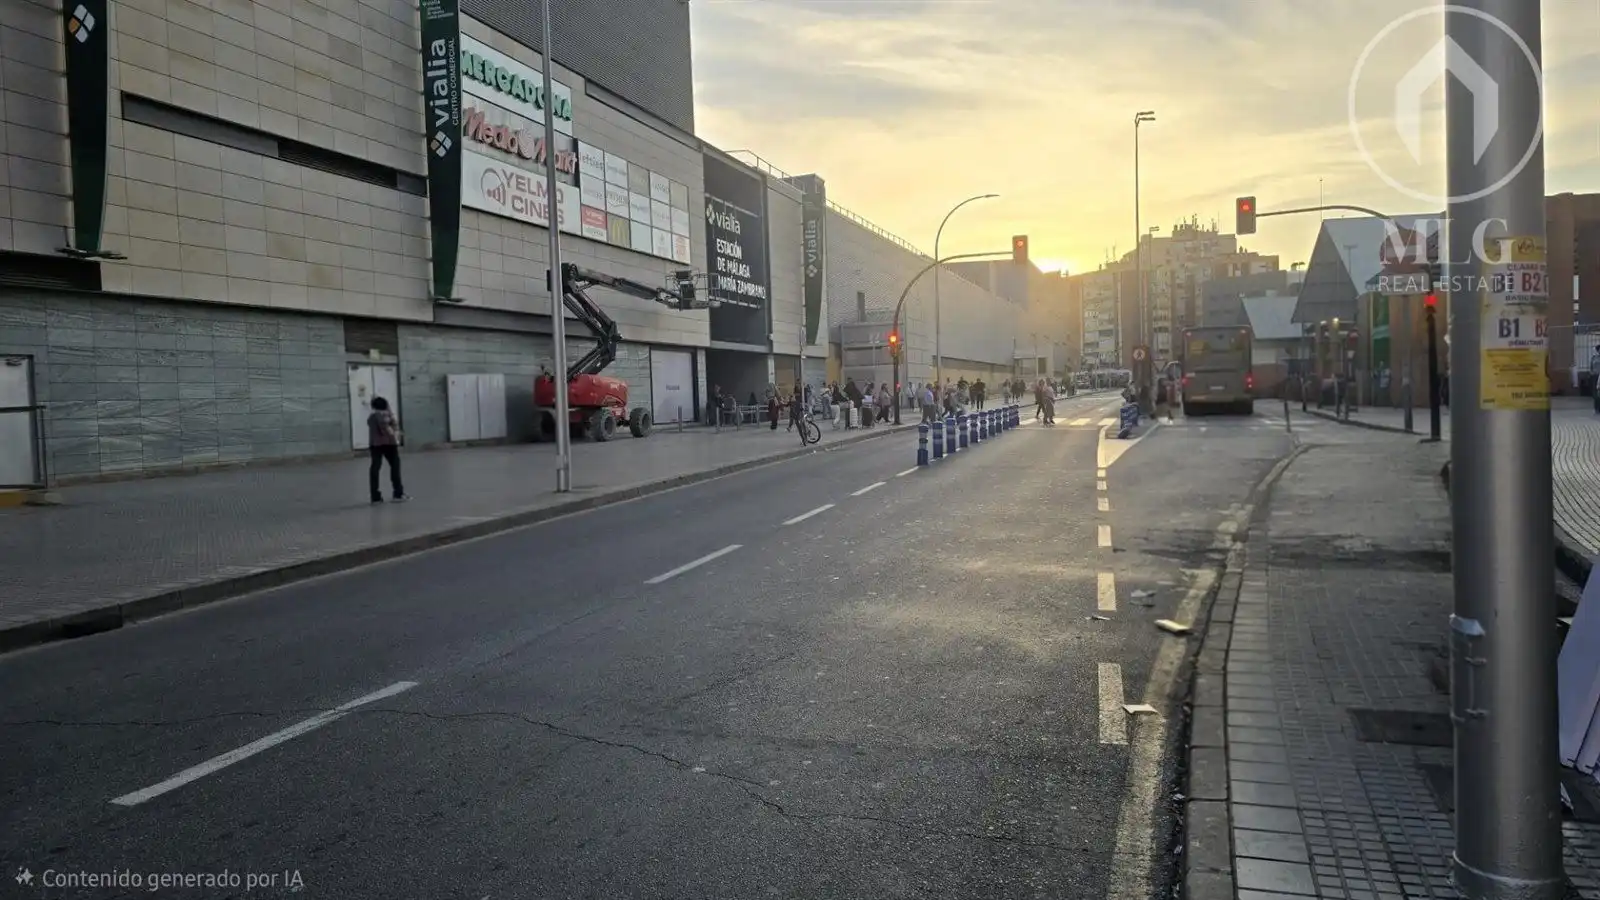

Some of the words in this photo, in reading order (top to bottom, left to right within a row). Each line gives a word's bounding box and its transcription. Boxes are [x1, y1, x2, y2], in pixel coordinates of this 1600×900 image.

[448, 38, 457, 90] COMERCIAL
[427, 38, 448, 127] vialia
[450, 91, 459, 126] CENTRO
[715, 210, 741, 235] vialia
[716, 237, 742, 260] ESTACIÓN
[805, 219, 818, 263] vialia
[717, 257, 726, 272] DE
[727, 257, 751, 278] MÁLAGA
[718, 274, 738, 293] MARÍA
[737, 280, 767, 299] ZAMBRANO
[1521, 272, 1542, 293] B2
[1498, 317, 1520, 338] B1
